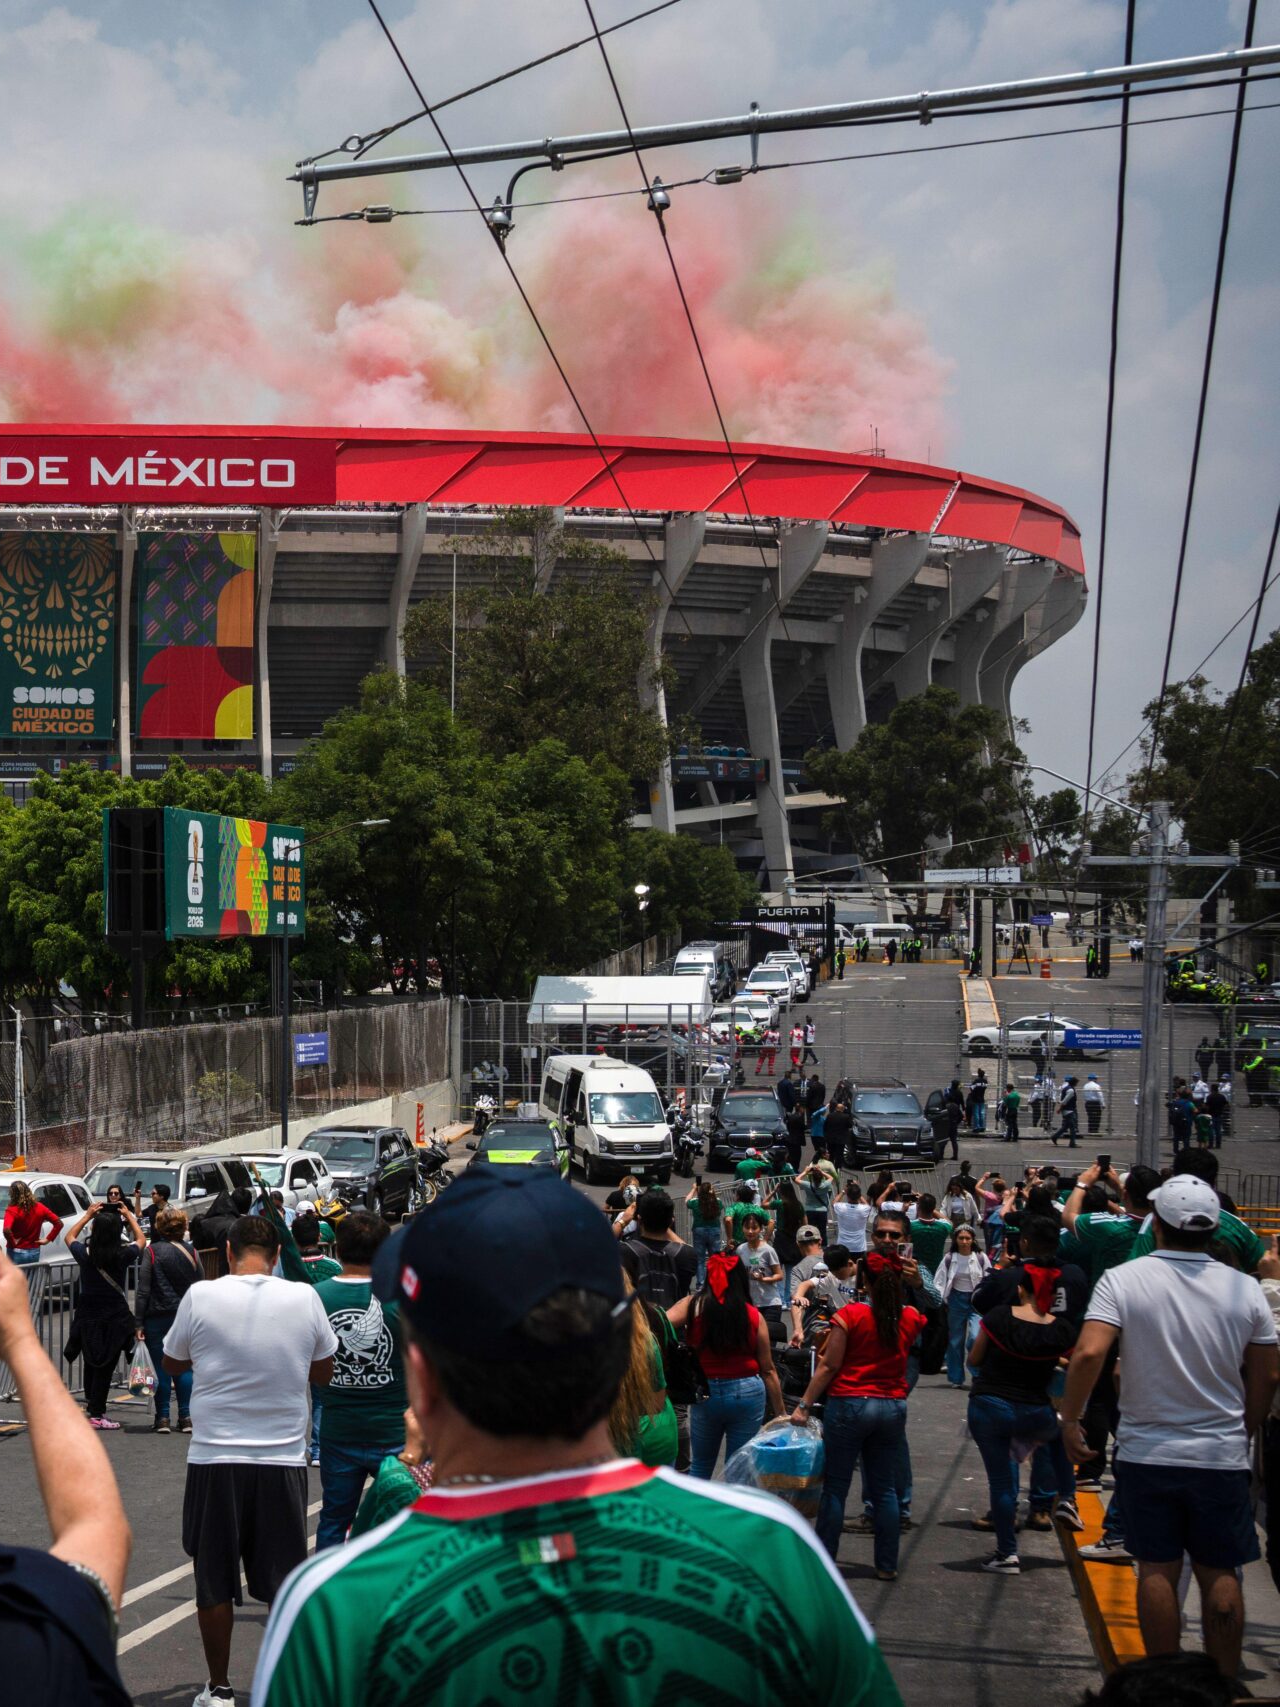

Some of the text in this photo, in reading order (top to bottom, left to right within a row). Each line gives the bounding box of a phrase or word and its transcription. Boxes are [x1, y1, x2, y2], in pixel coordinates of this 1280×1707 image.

[0, 456, 70, 485] DE
[90, 450, 295, 488] MÉXICO
[13, 687, 95, 704] SOMOS
[12, 708, 95, 720] CIUDAD DE
[12, 719, 95, 734] MÉXICO
[273, 883, 301, 901] MÉICO
[758, 907, 820, 917] PUERTA 1
[187, 916, 203, 927] 2026
[331, 1373, 390, 1386] MÉXICO
